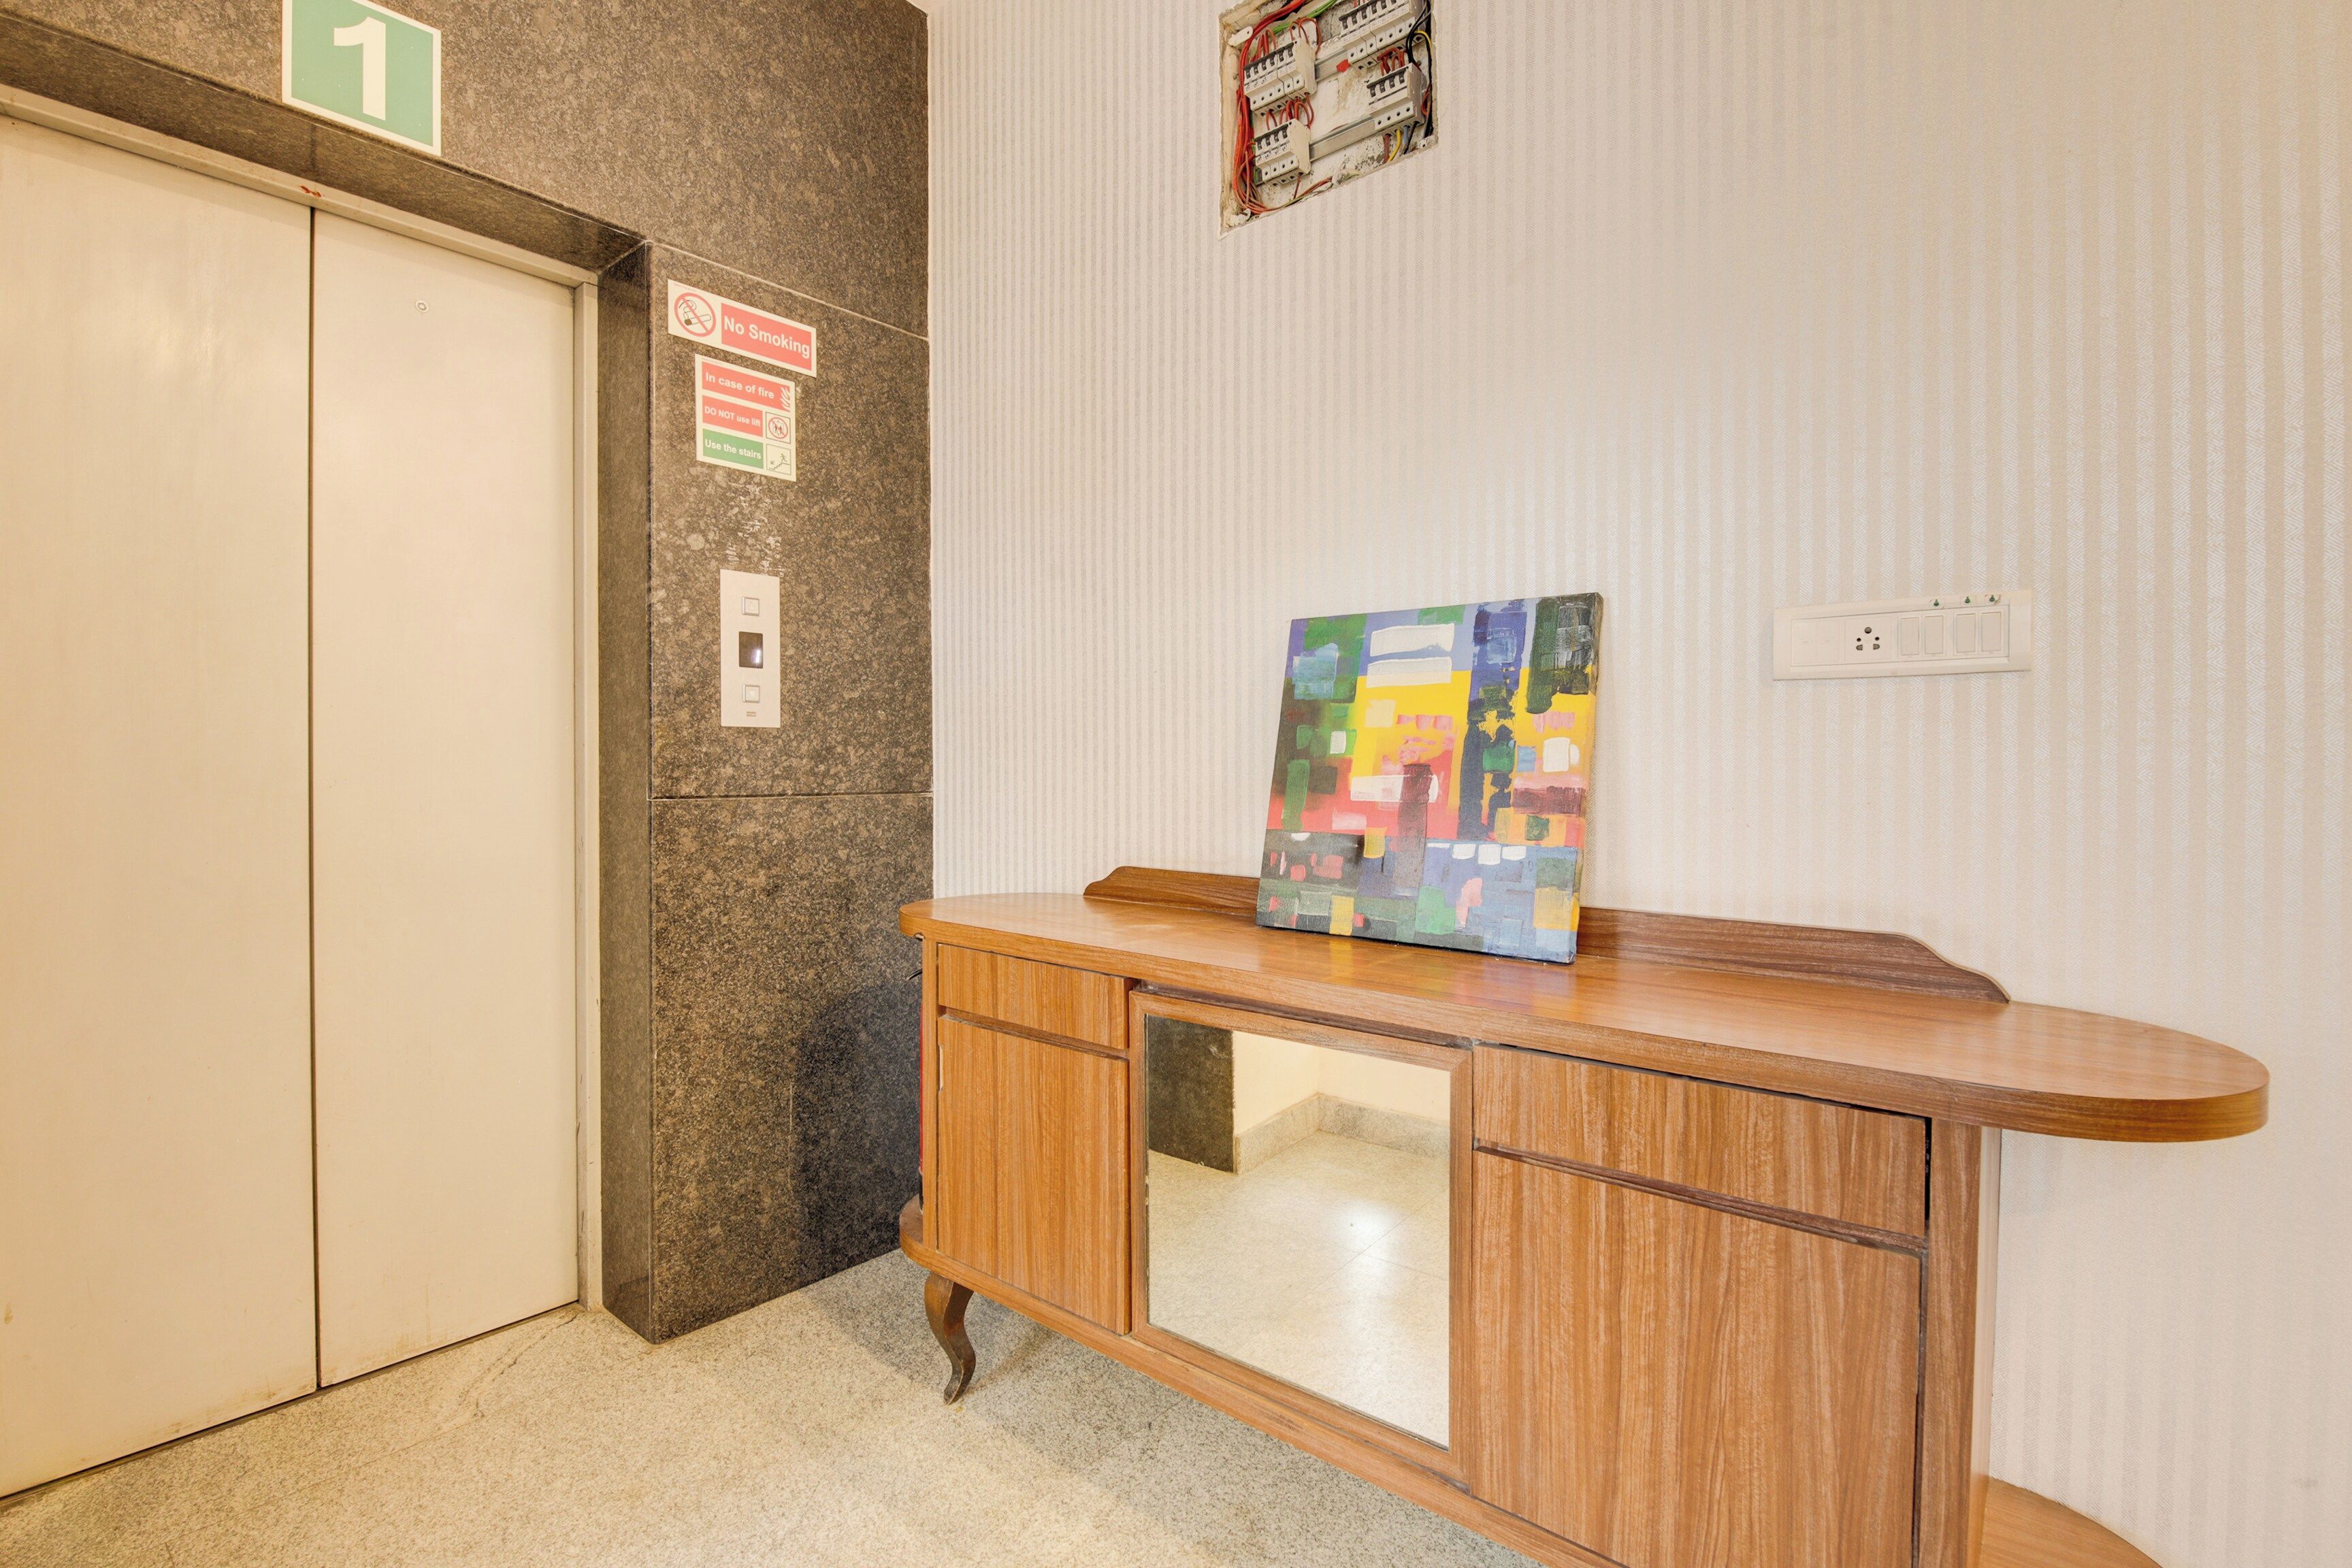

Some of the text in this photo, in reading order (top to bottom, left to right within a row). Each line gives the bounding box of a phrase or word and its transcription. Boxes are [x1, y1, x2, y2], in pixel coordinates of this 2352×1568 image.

[333, 16, 386, 121] 1
[723, 315, 811, 359] No Smoking
[706, 372, 774, 399] In case of fire
[704, 406, 762, 427] DO NOT use lift
[704, 438, 762, 459] Use the stairs
